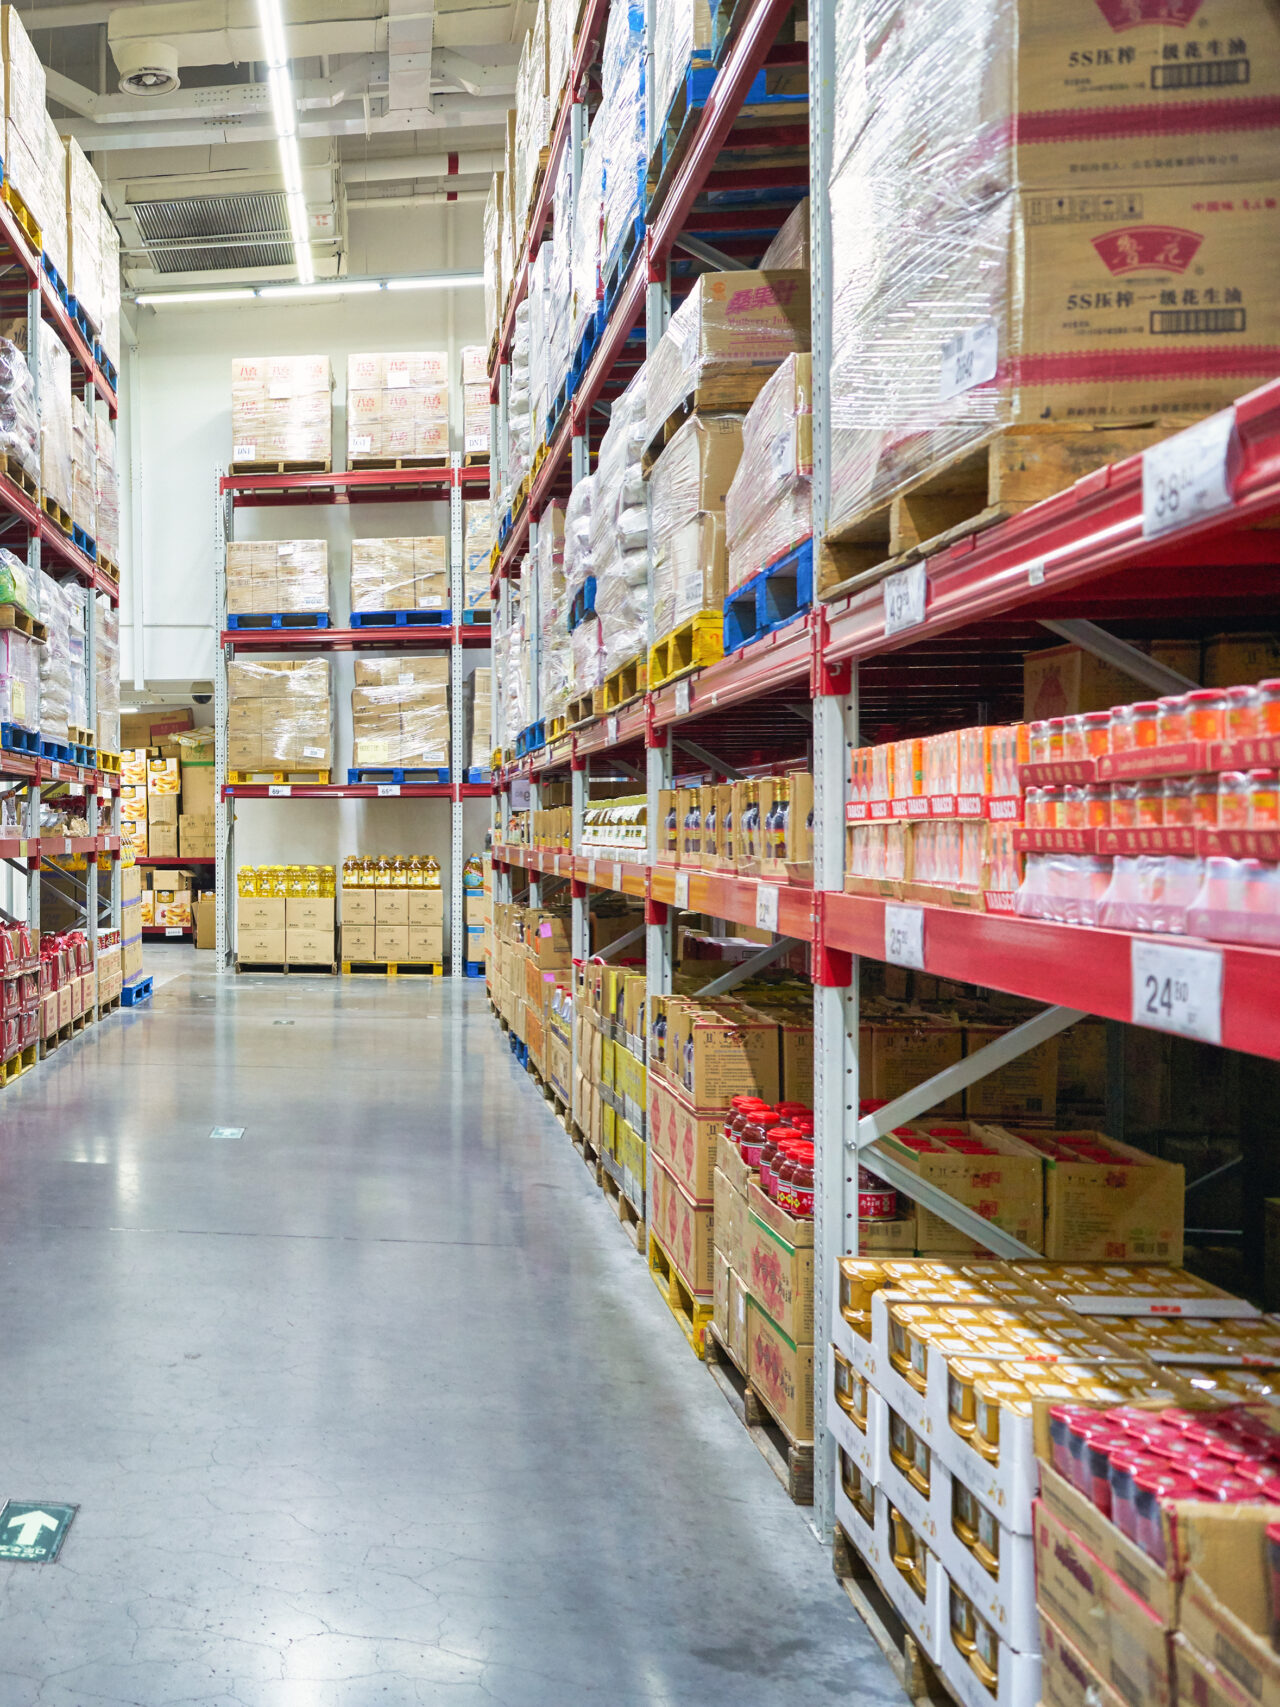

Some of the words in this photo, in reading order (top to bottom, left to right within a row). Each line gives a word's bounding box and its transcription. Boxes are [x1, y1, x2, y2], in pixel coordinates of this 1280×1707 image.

[846, 803, 866, 819] TABASCO
[891, 800, 908, 816] TABASC
[907, 797, 929, 814] TABASCO
[931, 796, 954, 813] TABASCO
[957, 796, 981, 814] TABASCO
[988, 799, 1018, 820] TABASCO
